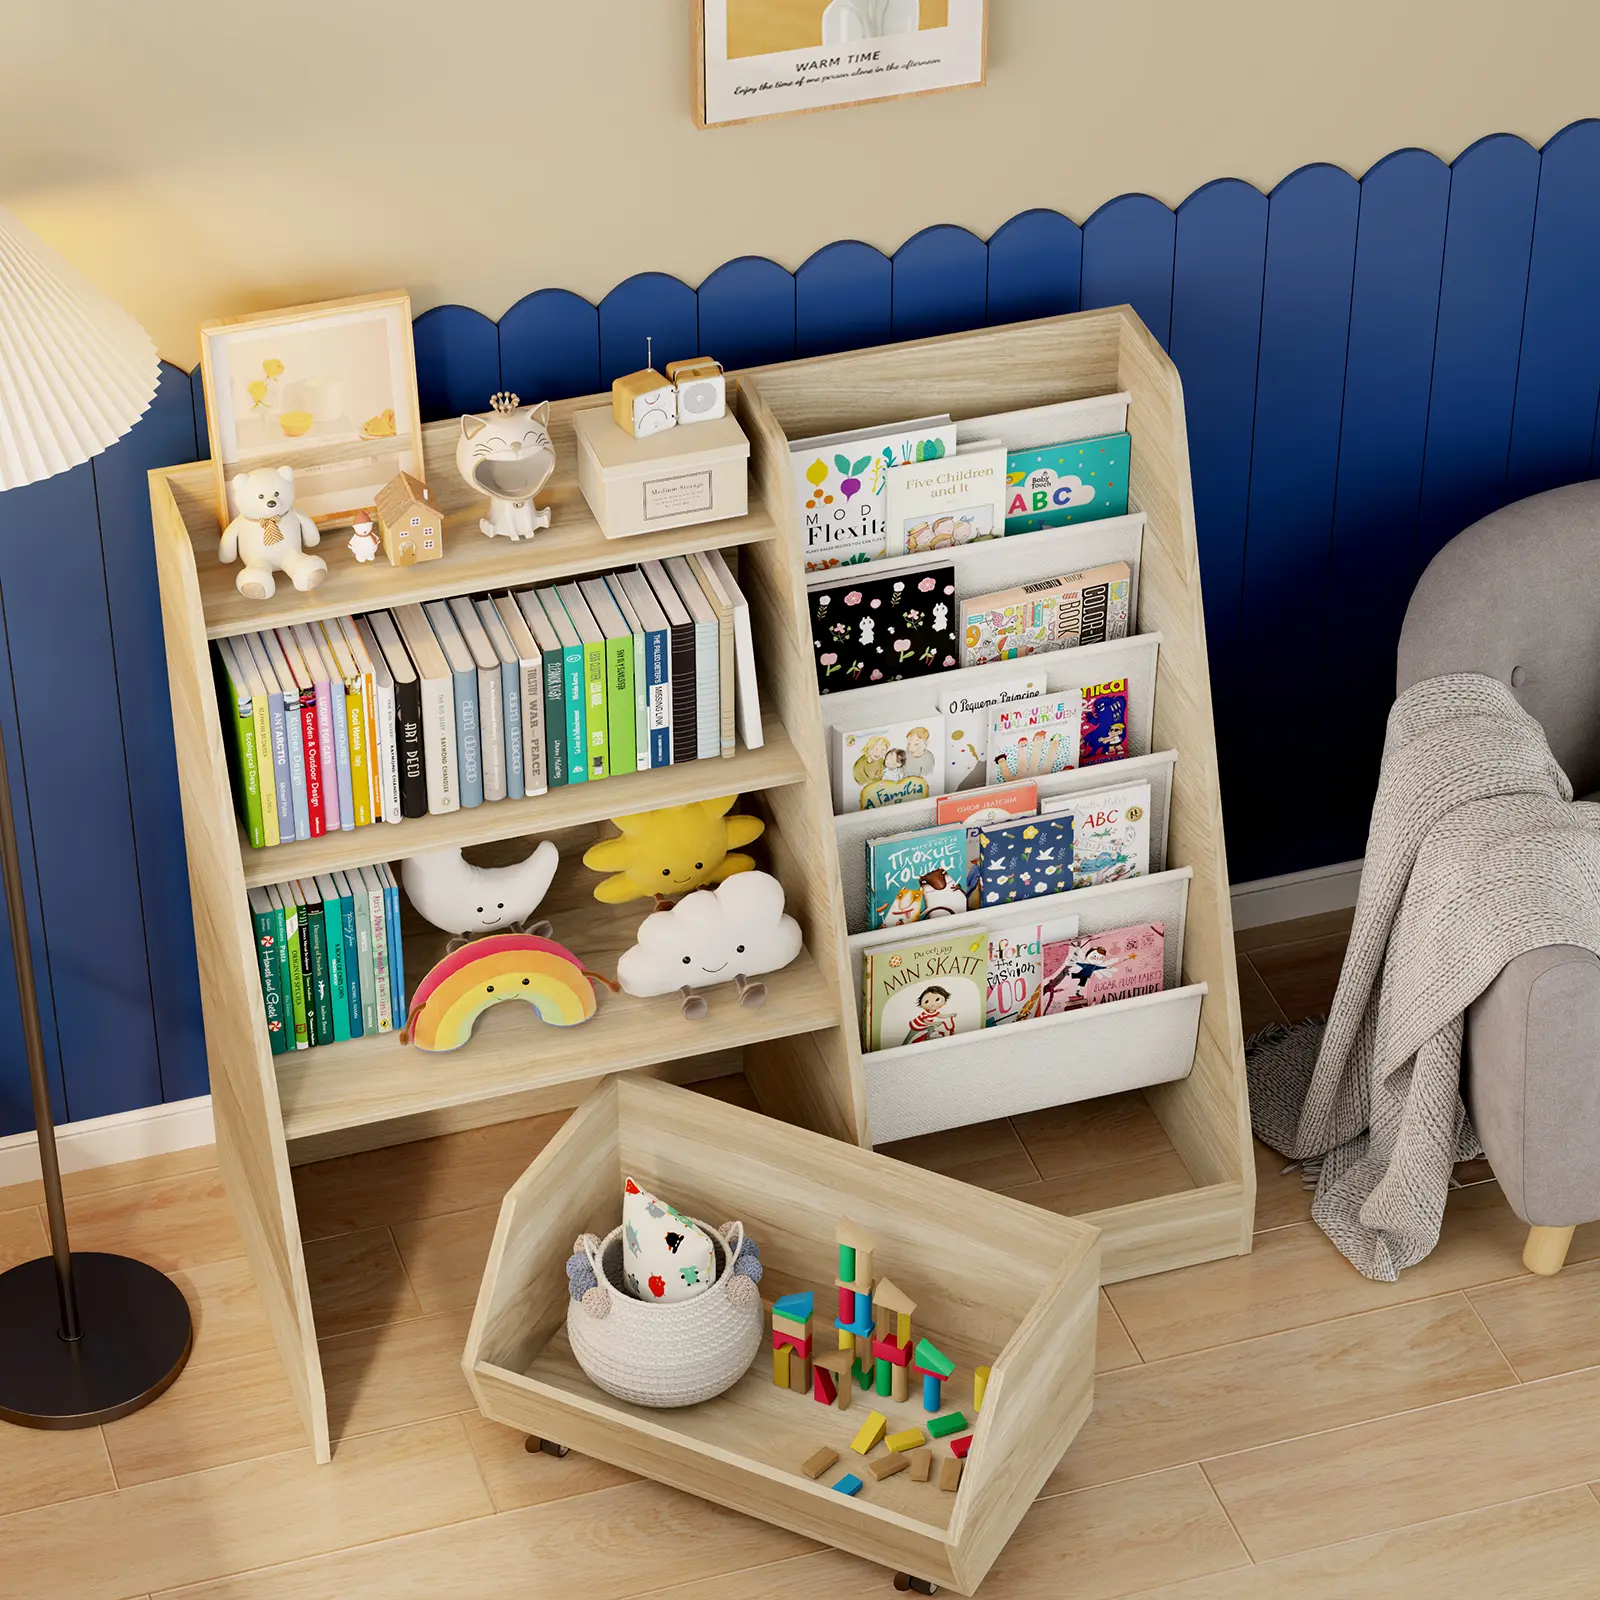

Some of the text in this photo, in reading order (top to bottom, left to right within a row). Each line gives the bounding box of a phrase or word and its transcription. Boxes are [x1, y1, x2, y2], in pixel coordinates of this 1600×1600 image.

[796, 51, 881, 72] WARM TIME
[734, 58, 941, 95] Enjoy the time of one person alone in the afternoon
[906, 467, 994, 490] Five Children
[931, 483, 968, 498] and It
[1057, 600, 1080, 639] BOOK
[653, 645, 661, 661] PALEO
[319, 696, 329, 728] LUXURY
[336, 694, 345, 728] LUXURY
[655, 686, 663, 711] MISSING
[949, 700, 958, 714] O
[305, 712, 315, 740] Garden
[352, 708, 361, 751] Cool Hotels
[509, 691, 520, 774] art deco
[527, 668, 541, 776] TOLSTOY WAR PEACE
[655, 712, 663, 727] LINK
[245, 732, 255, 768] Ecological
[274, 712, 286, 765] ANTARCTIC
[290, 716, 302, 786] Kitchen Design
[404, 722, 420, 778] ART DECO
[463, 700, 477, 784] art deco
[308, 749, 317, 780] Outdoor
[323, 745, 332, 765] CATS
[311, 782, 319, 807] Design
[864, 799, 876, 809] A
[1081, 809, 1119, 829] ABC
[914, 951, 924, 960] Du
[995, 958, 1013, 971] the
[263, 950, 279, 1018] Hansel and Gretel
[883, 956, 984, 996] MIN SKATT
[1093, 981, 1117, 993] SUGAR
[1119, 976, 1137, 988] PLUM
[294, 982, 302, 1006] SPECIES
